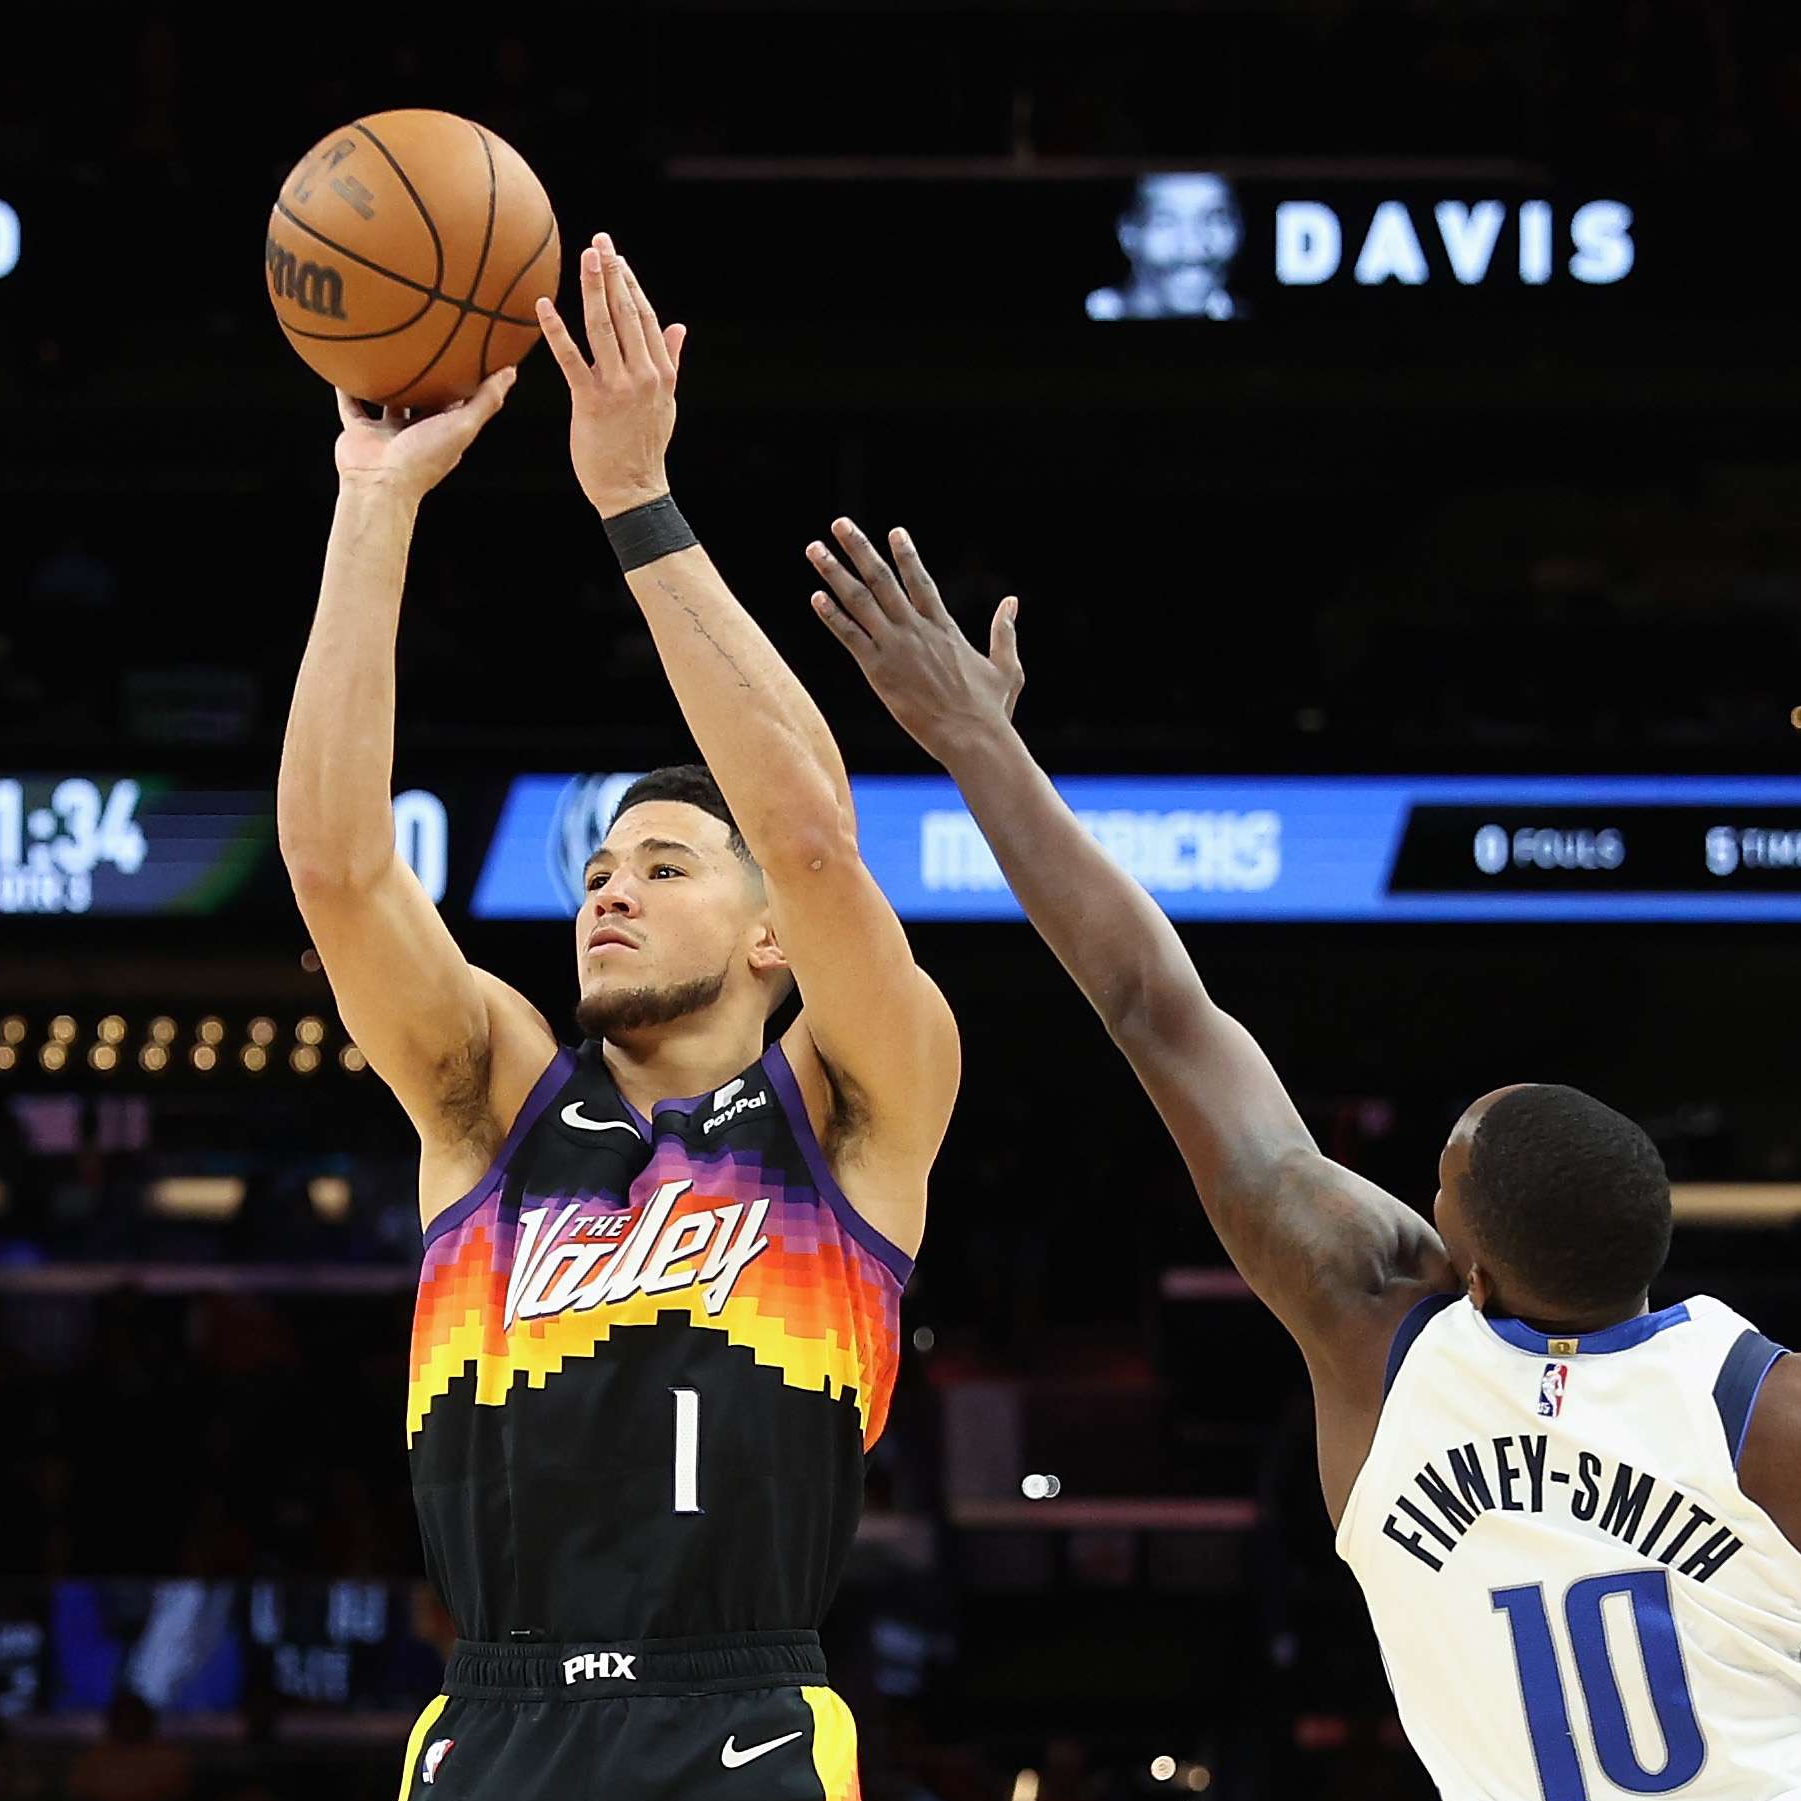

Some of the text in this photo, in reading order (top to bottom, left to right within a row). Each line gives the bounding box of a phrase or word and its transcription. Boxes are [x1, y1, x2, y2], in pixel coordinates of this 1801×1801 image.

[1275, 199, 1636, 285] DAVIS
[1473, 824, 1626, 874] 0 FOULS
[702, 1090, 768, 1135] PayPal
[503, 1178, 772, 1332] Valley
[568, 1215, 632, 1238] THE
[669, 1386, 704, 1515] 1
[1382, 1434, 1744, 1584] FINNEY-SMITH
[562, 1651, 637, 1686] PHX
